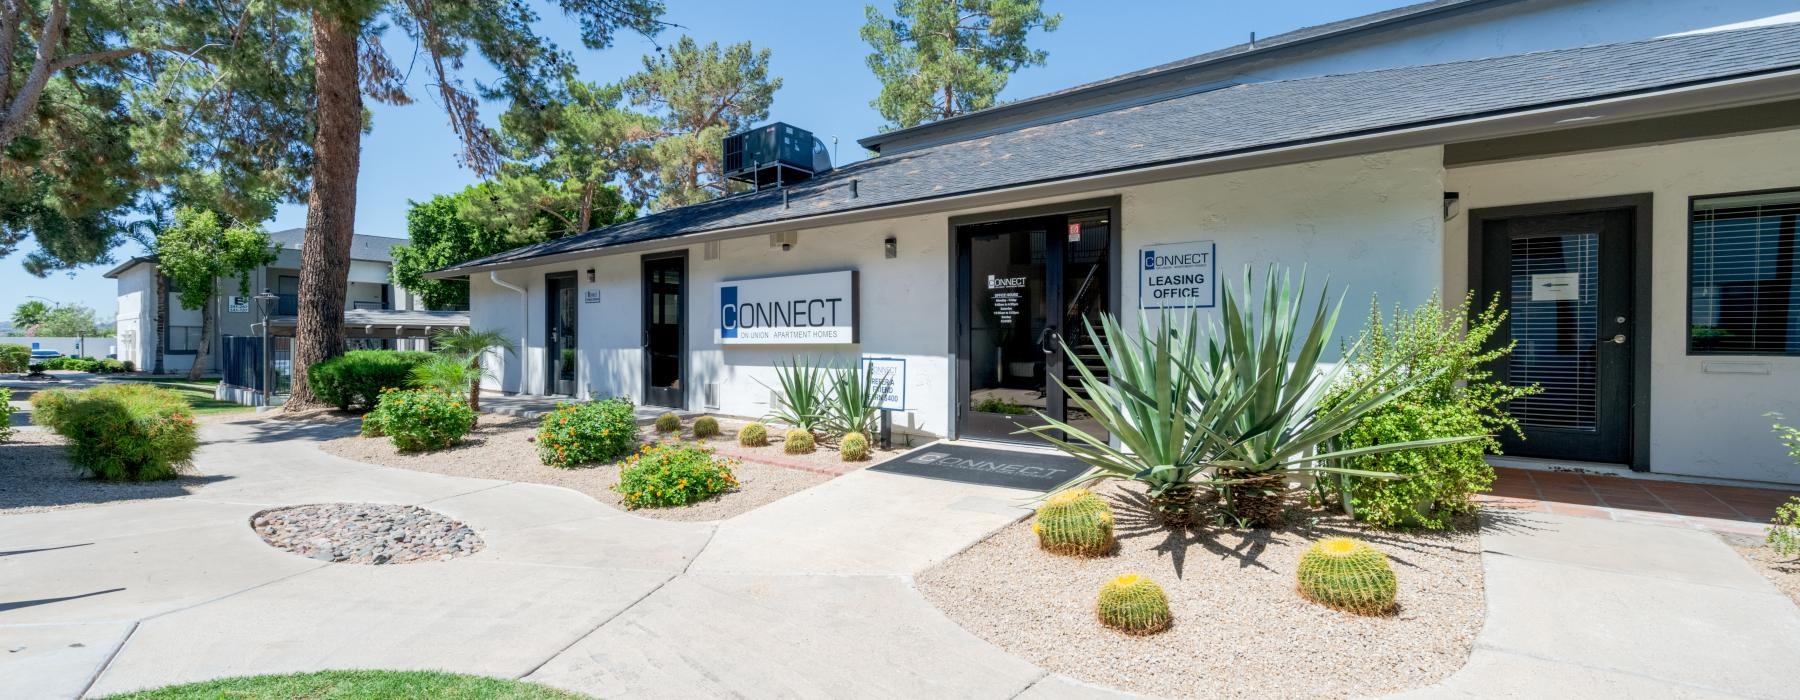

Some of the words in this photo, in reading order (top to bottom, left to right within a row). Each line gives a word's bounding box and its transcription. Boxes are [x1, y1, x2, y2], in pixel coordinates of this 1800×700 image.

[1145, 252, 1208, 268] CONNECT
[1148, 274, 1204, 286] LEASING
[1154, 288, 1200, 298] OFFICE
[722, 298, 842, 330] CONNECT
[917, 454, 1066, 478] CONNECT
